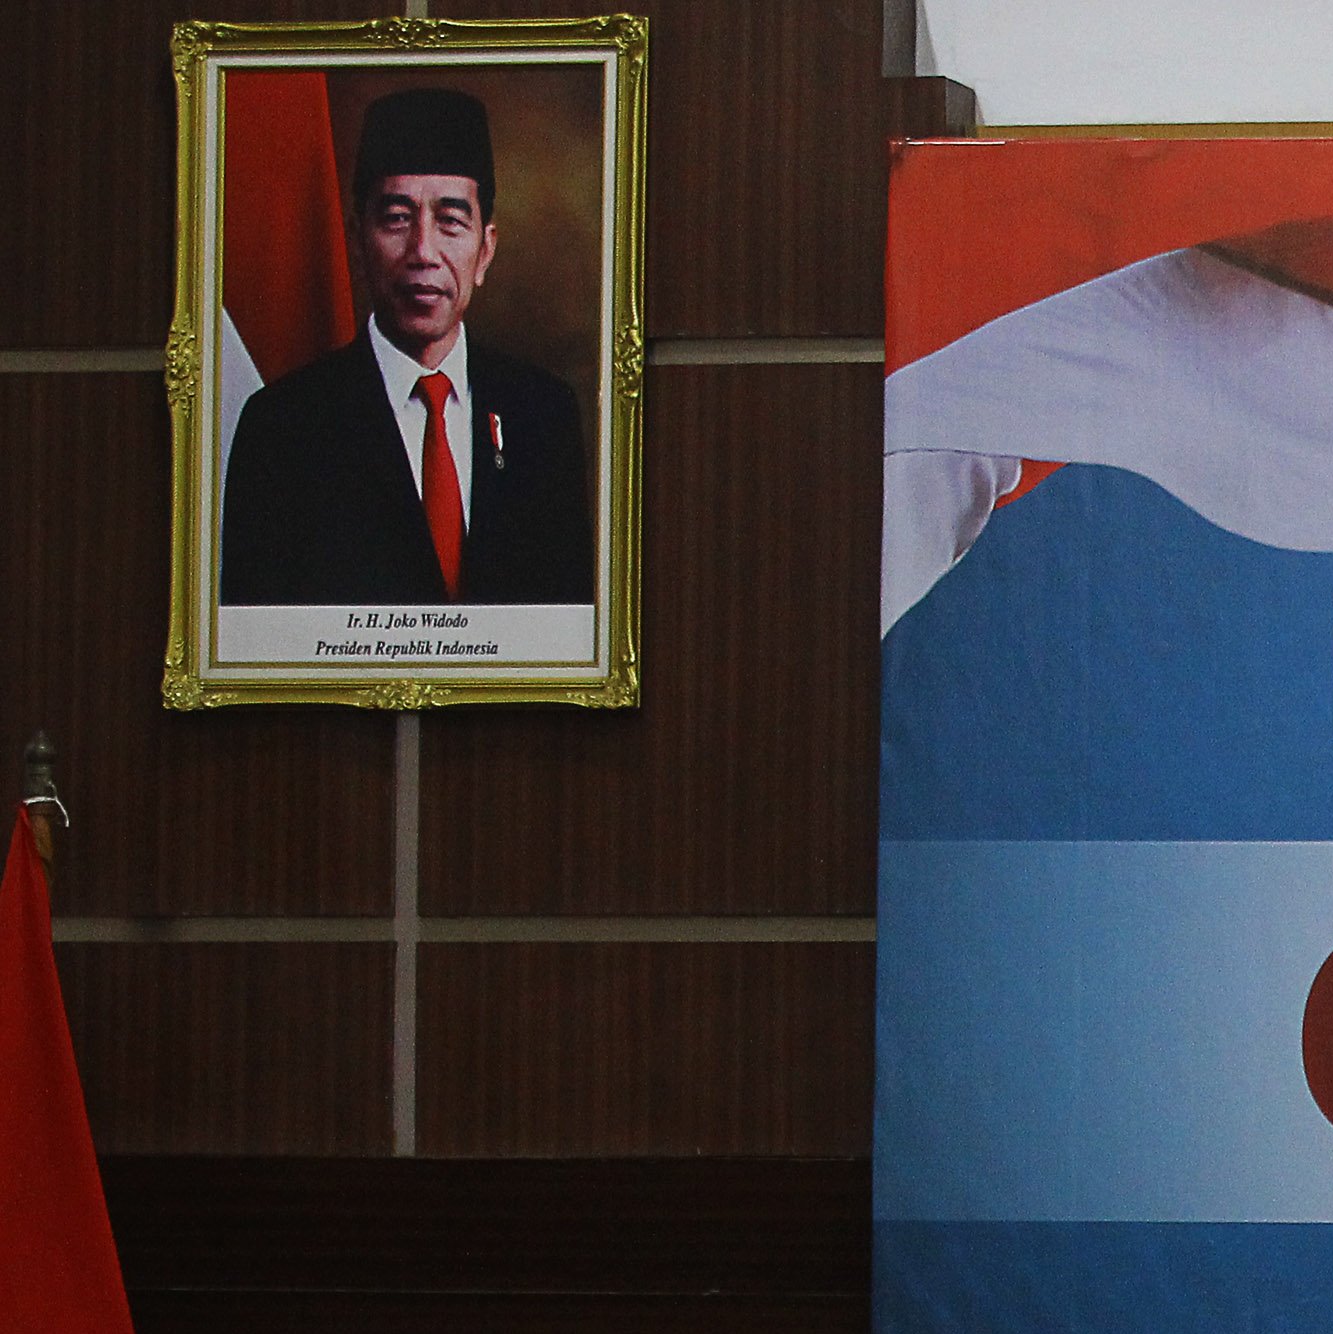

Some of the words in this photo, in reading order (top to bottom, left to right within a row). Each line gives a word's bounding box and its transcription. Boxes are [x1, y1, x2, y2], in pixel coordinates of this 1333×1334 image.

[347, 613, 363, 629] Ir.
[366, 613, 382, 629] H.
[385, 613, 417, 630] Joko
[421, 613, 468, 629] Widodo
[315, 641, 371, 656] Presiden
[375, 641, 432, 659] Republik
[435, 641, 498, 656] Indonesia
